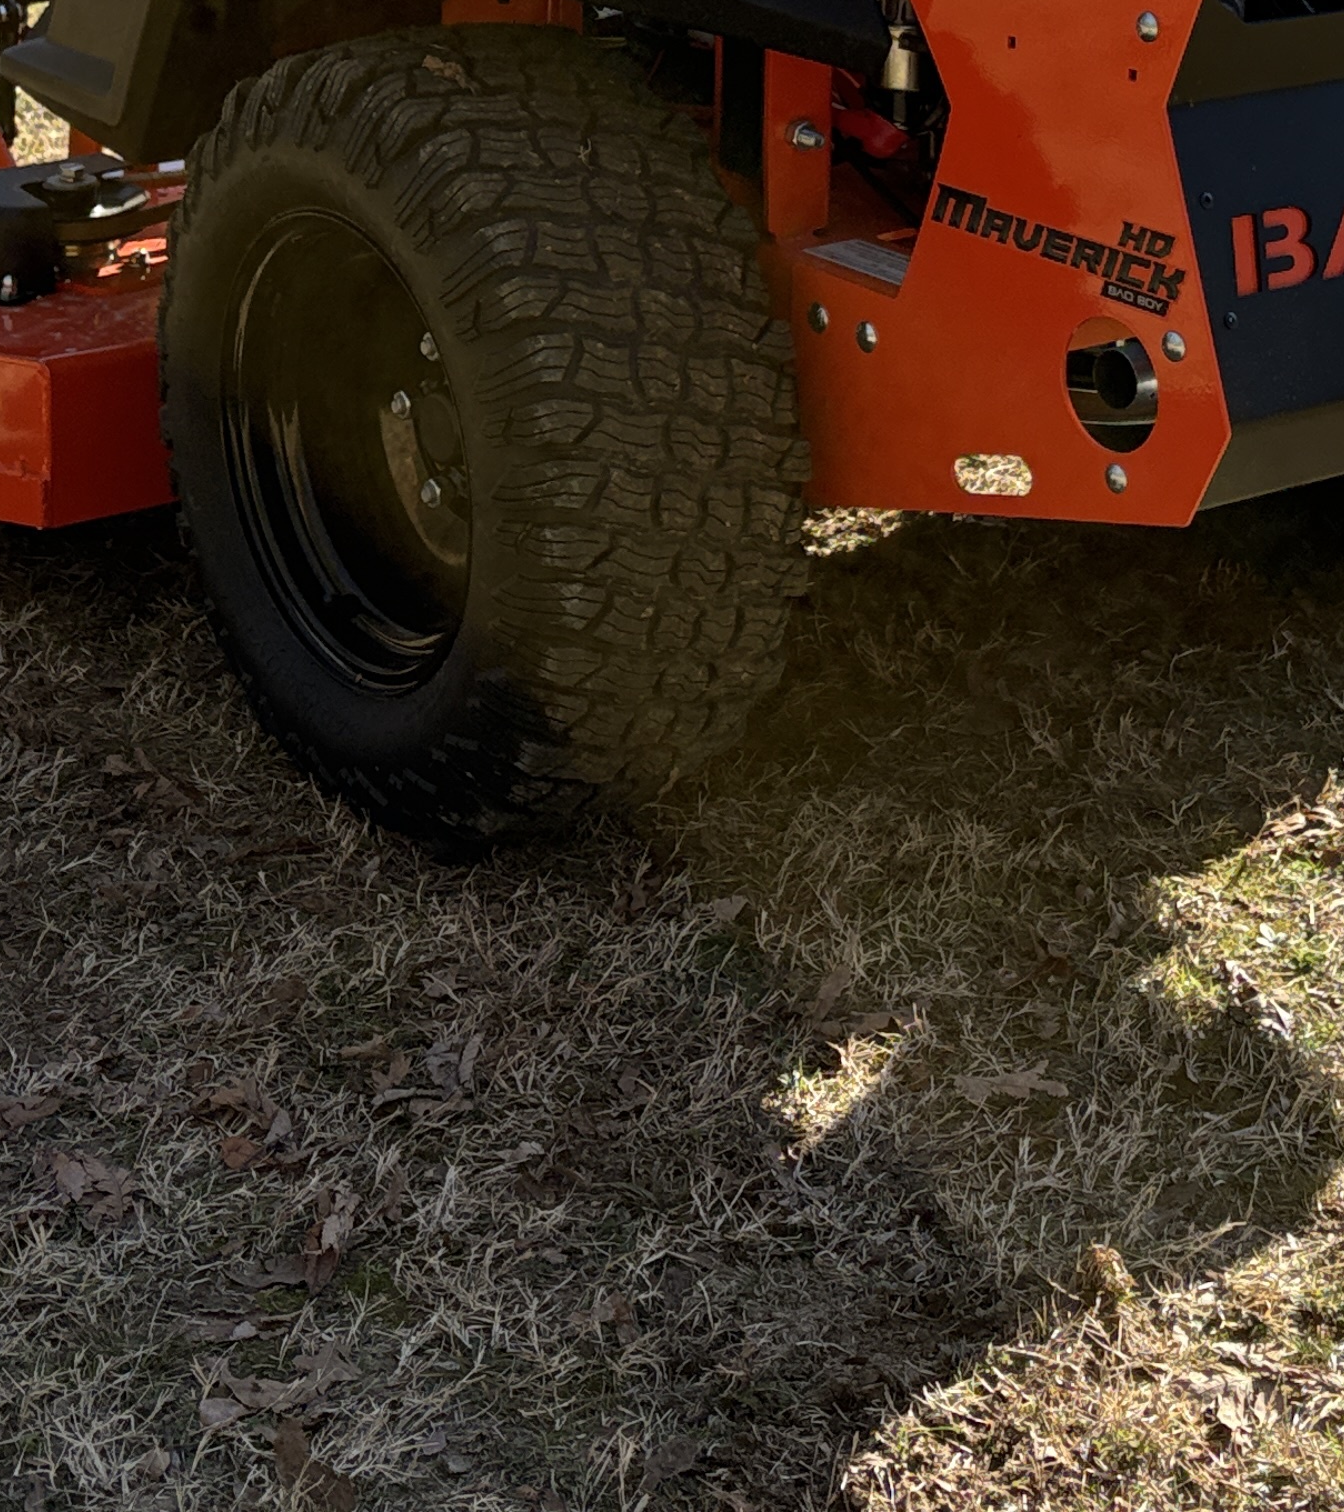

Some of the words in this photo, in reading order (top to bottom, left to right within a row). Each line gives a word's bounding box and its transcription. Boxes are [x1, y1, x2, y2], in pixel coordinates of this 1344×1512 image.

[930, 182, 1186, 301] MAVERICK
[1117, 220, 1176, 259] HD
[1107, 284, 1134, 304] BAD
[1136, 296, 1165, 314] BOY
